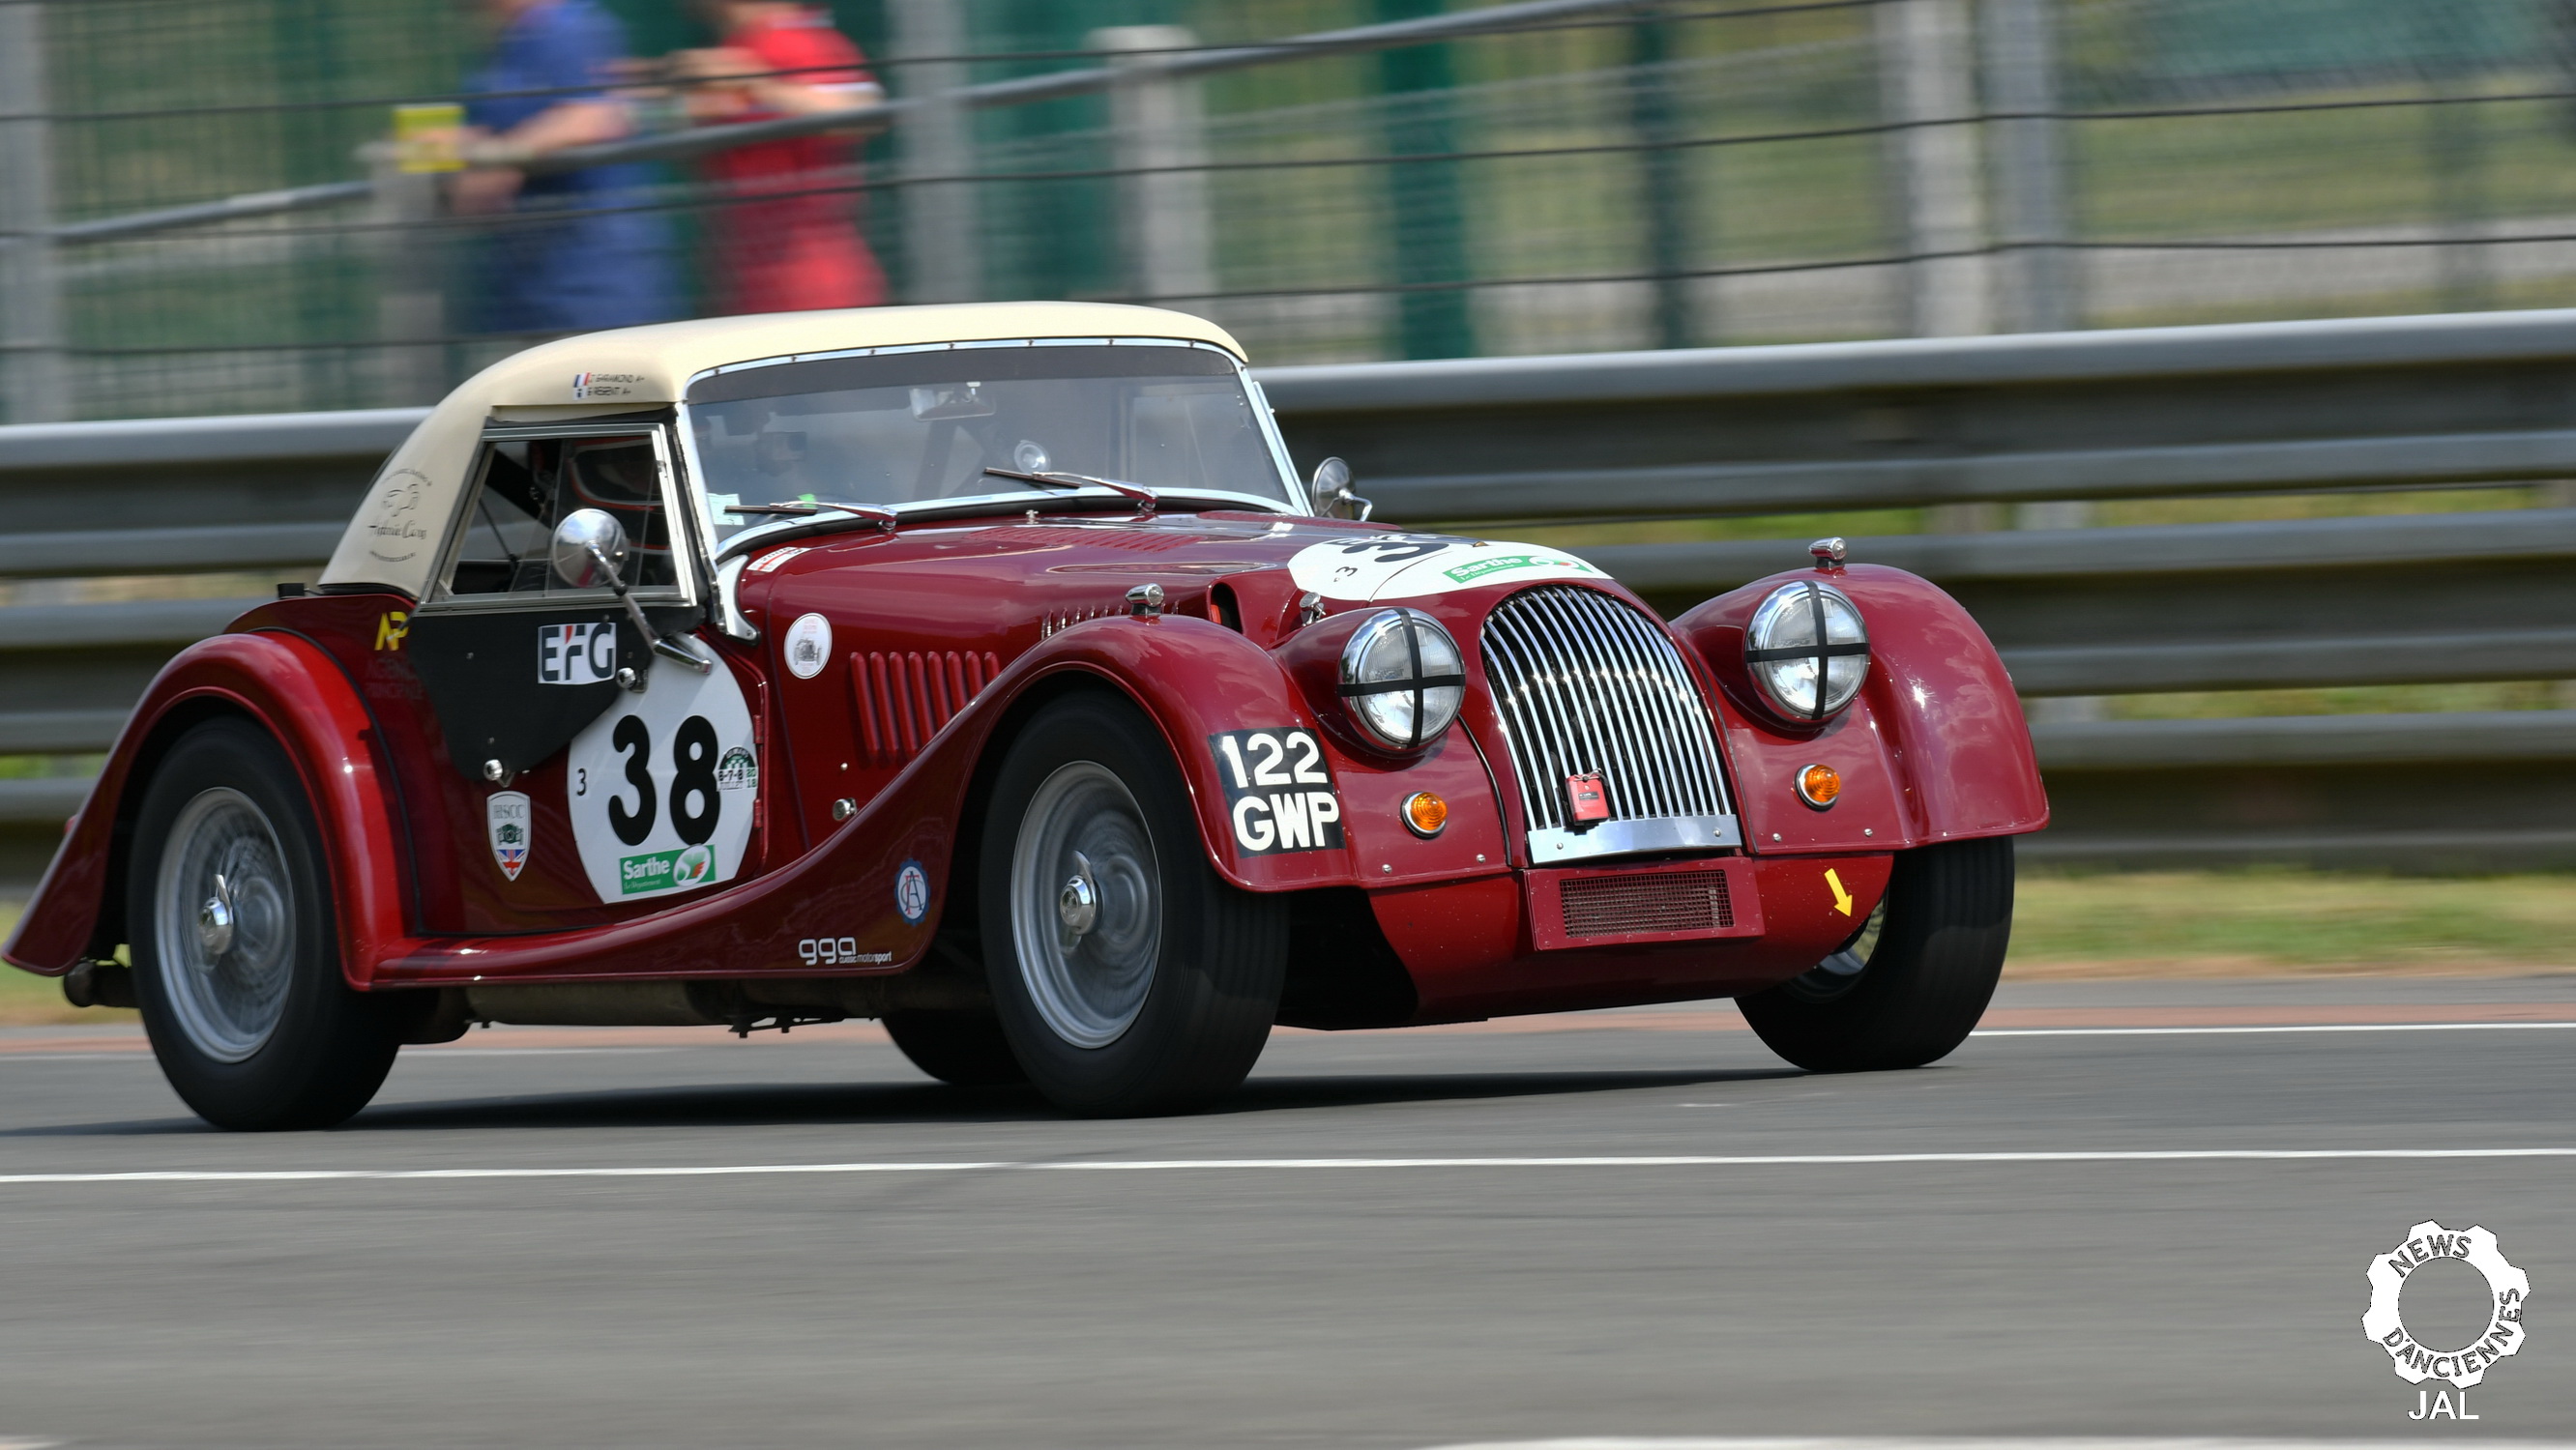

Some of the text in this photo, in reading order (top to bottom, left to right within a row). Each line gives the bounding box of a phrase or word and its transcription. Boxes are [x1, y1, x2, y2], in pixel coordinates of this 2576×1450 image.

[1450, 557, 1523, 577] Sarthe
[542, 623, 613, 682] EFG
[576, 768, 587, 797] 3
[608, 714, 720, 847] 38
[1222, 732, 1328, 788] 122
[1233, 792, 1339, 851] GWP
[623, 856, 670, 880] Sarthe
